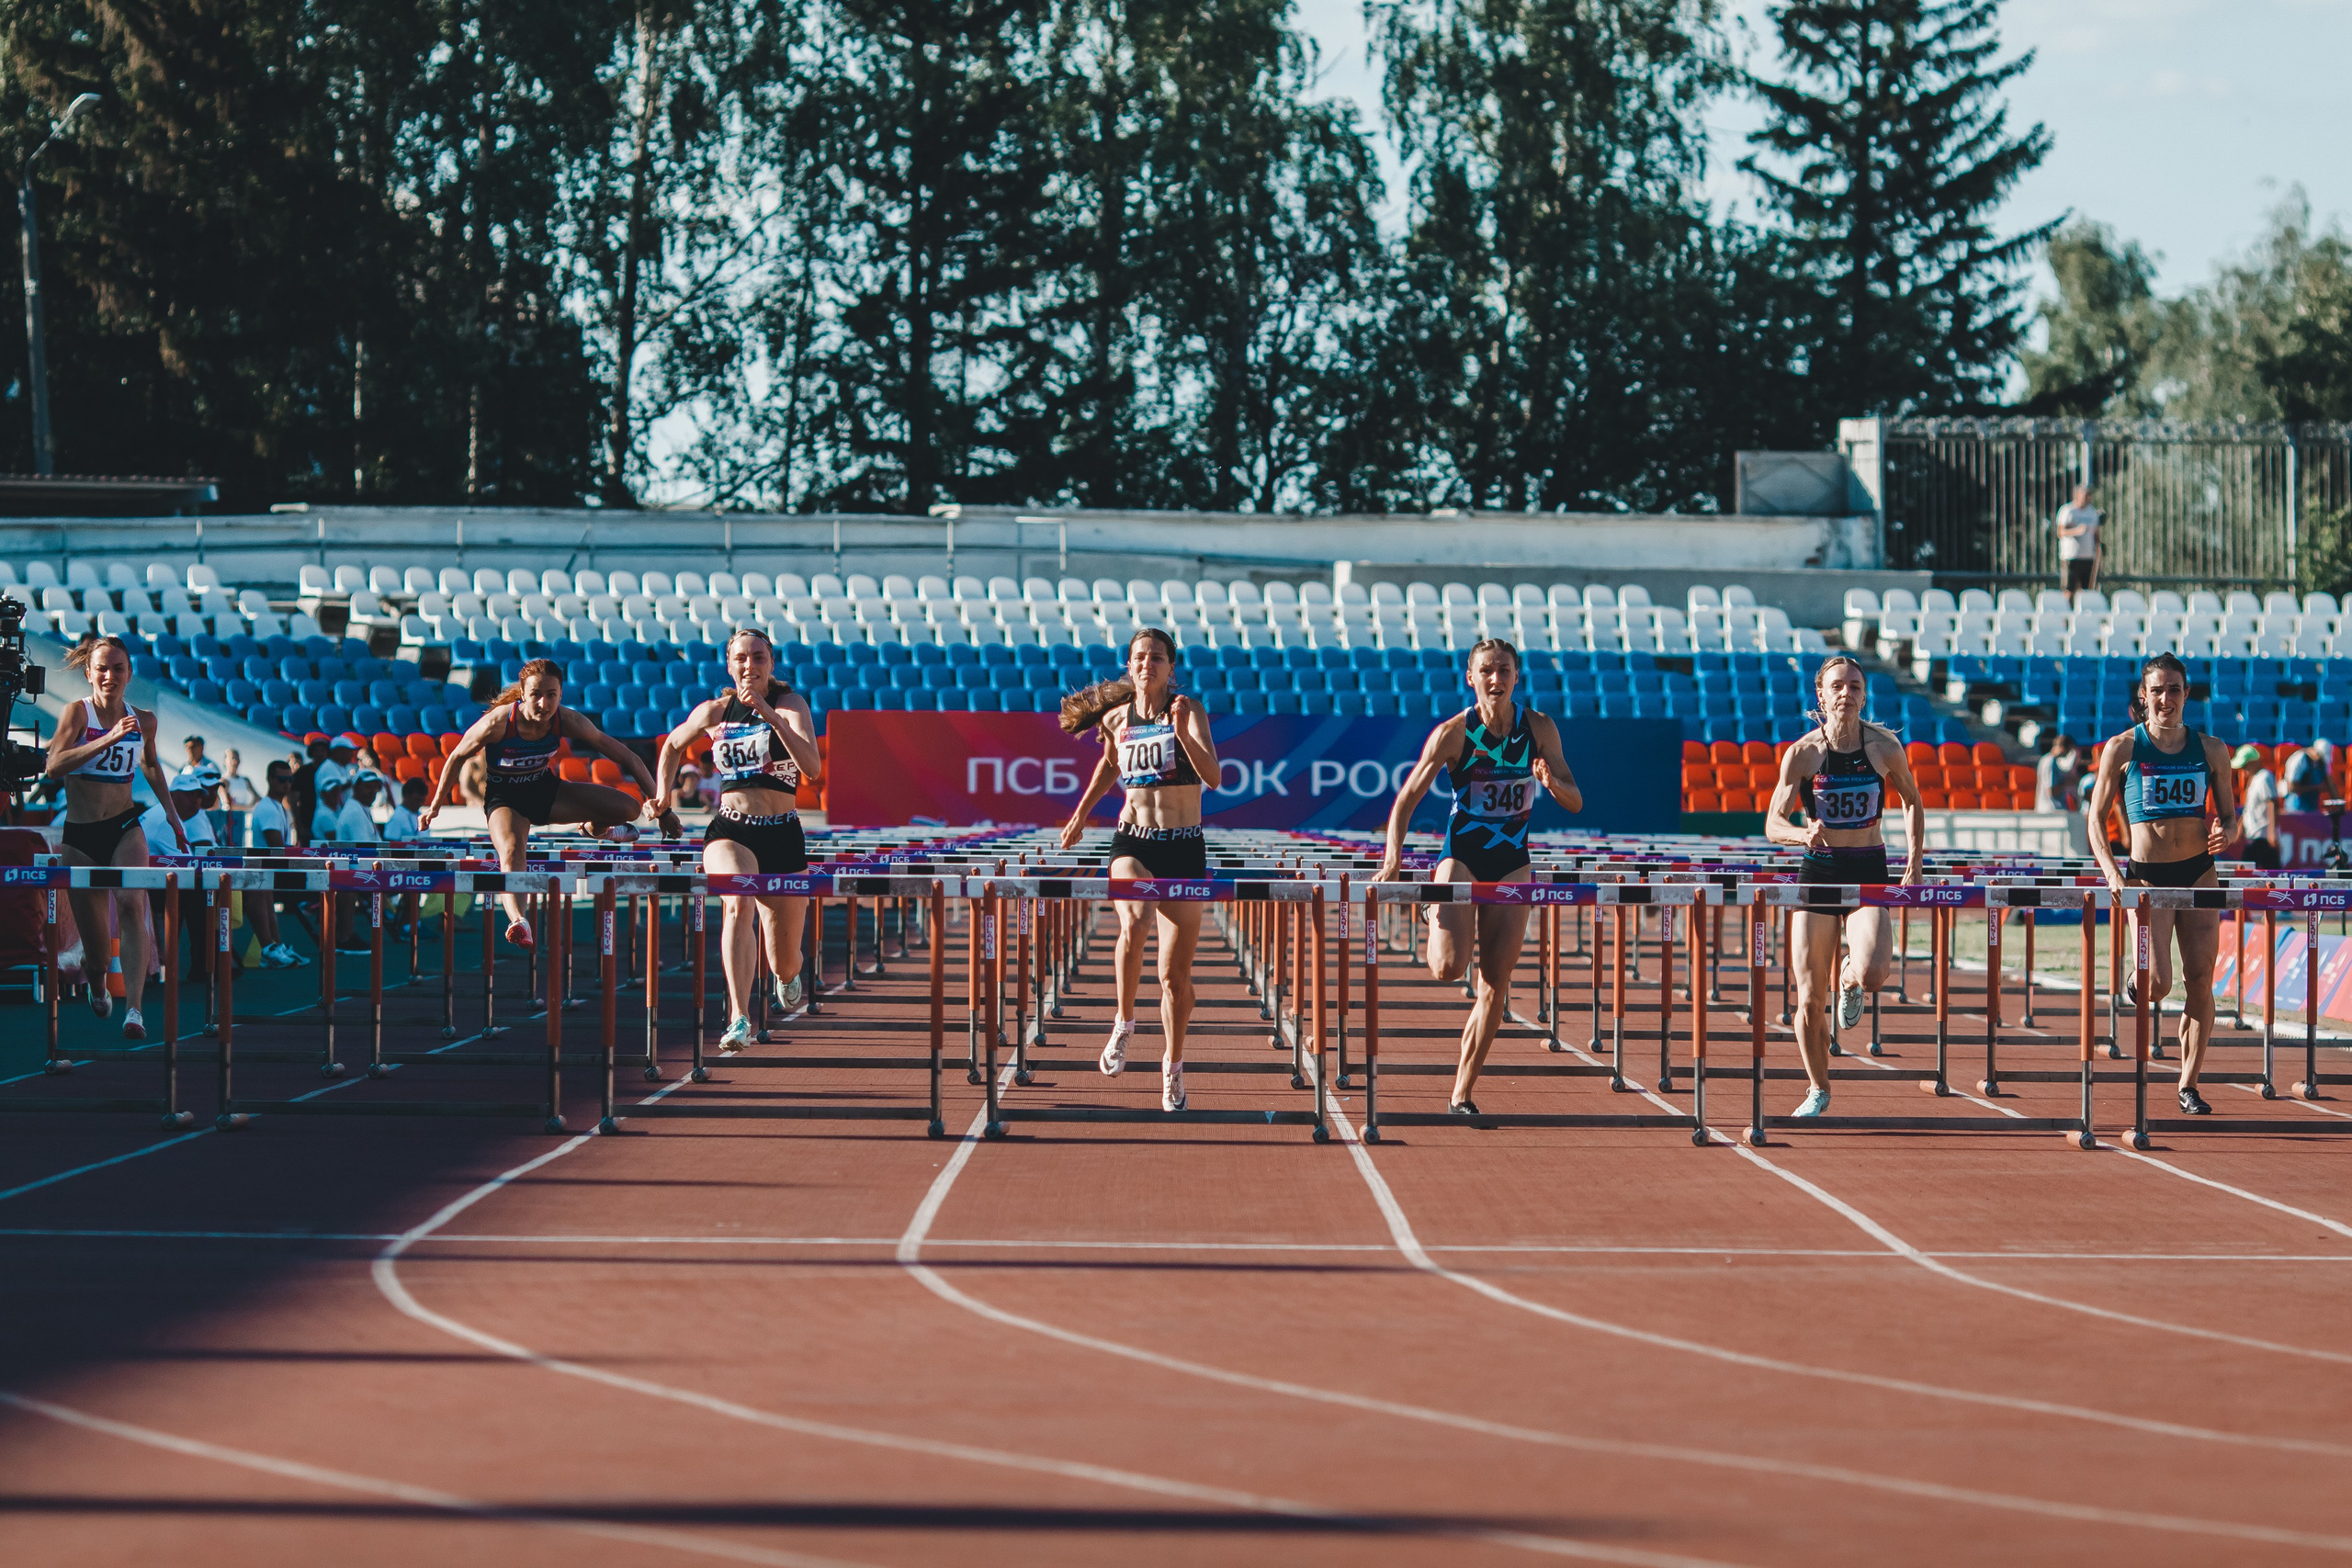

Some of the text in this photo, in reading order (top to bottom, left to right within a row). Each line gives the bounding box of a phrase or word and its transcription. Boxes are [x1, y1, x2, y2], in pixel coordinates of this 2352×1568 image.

[96, 746, 135, 773] 251
[719, 739, 760, 769] 354
[1125, 741, 1162, 772] 700
[508, 773, 540, 784] NIKE
[967, 756, 1080, 795] ПСБ
[1482, 784, 1526, 812] 348
[2154, 778, 2196, 805] 549
[1826, 792, 1869, 818] 353
[745, 813, 784, 826] NIKE
[1128, 823, 1168, 841] NIKE
[1171, 825, 1202, 840] PRO
[21, 870, 47, 880] ПСБ
[405, 875, 431, 886] ПСБ
[784, 880, 809, 890] ПСБ
[1185, 886, 1211, 896] ПСБ
[1548, 890, 1573, 900] ПСБ
[1937, 890, 1962, 900] ПСБ
[2320, 895, 2346, 905] ПСБ
